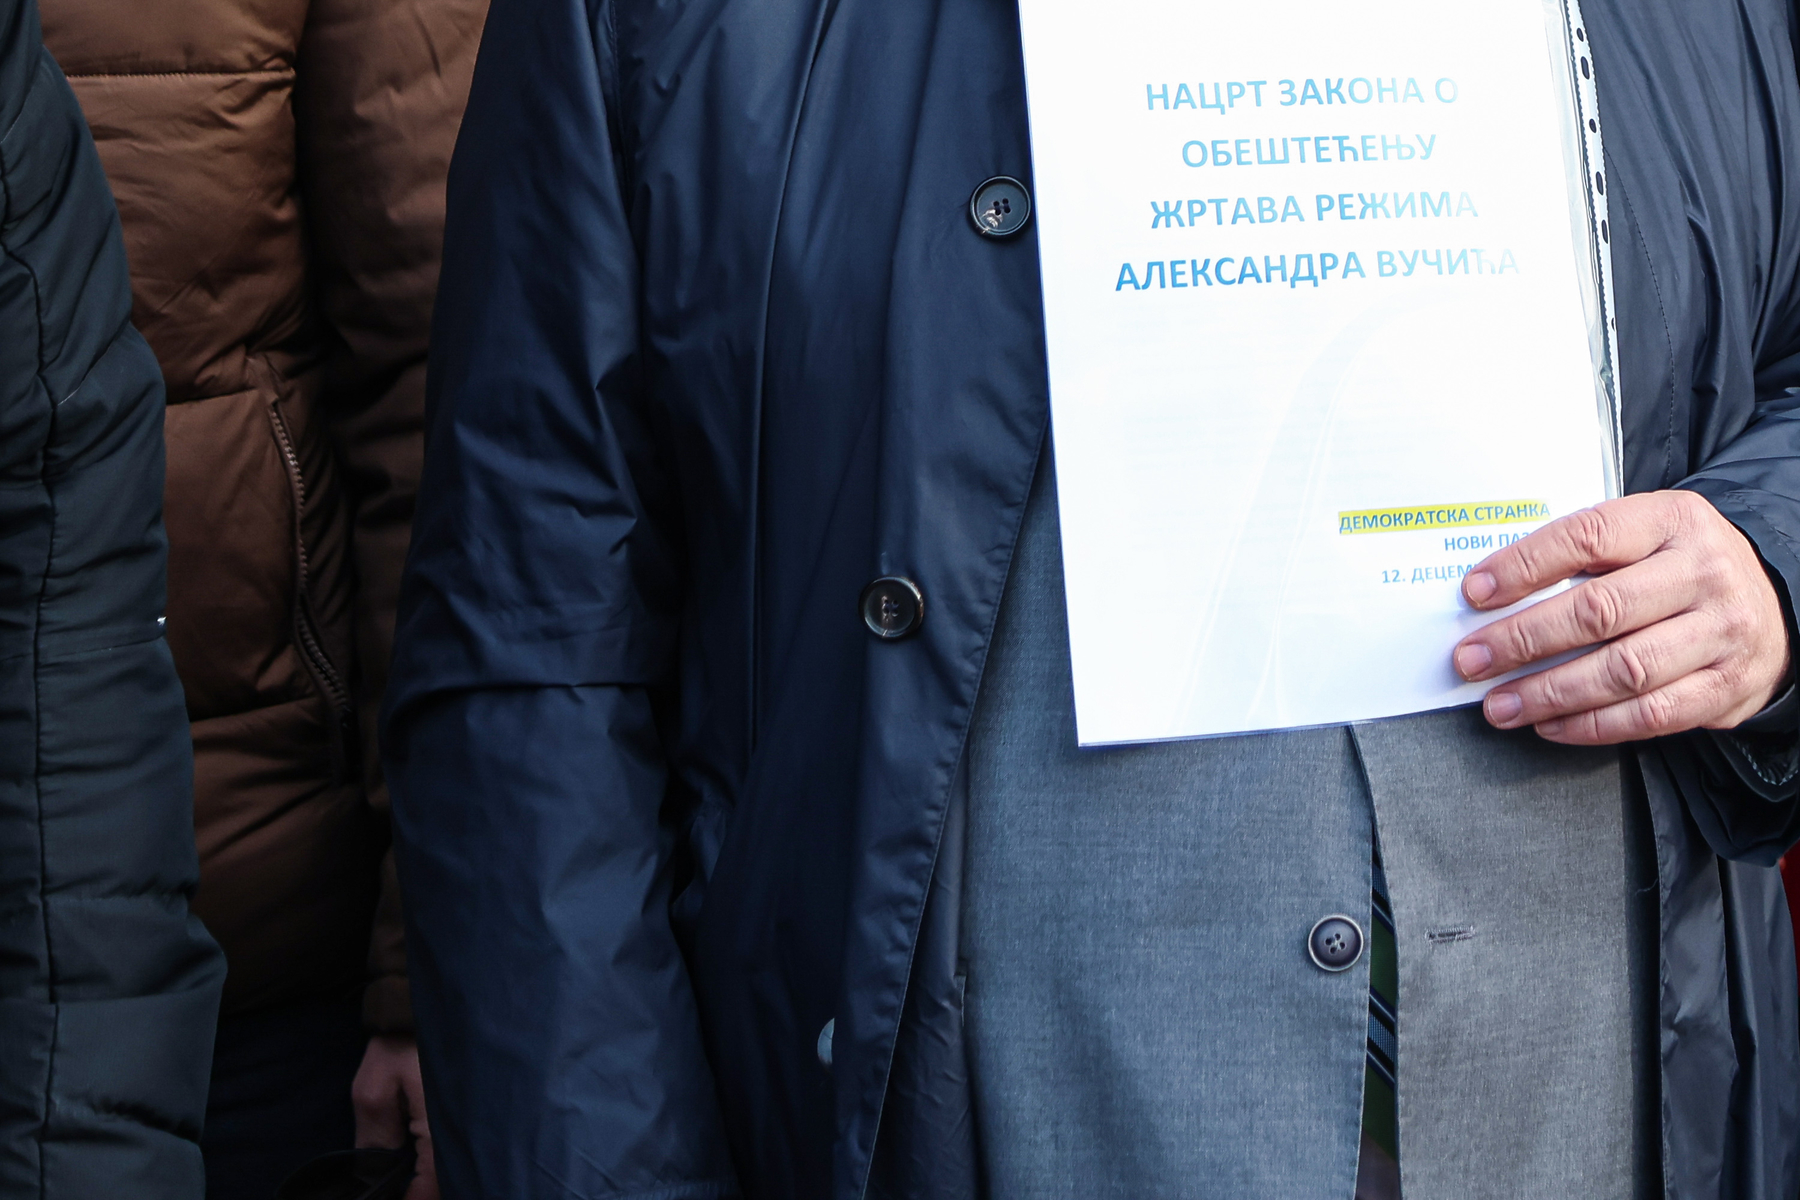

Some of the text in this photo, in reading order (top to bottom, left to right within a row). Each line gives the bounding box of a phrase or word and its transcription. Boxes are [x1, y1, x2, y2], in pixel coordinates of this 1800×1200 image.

[1146, 77, 1459, 115] НАЦРТ ЗАКОНА О
[1181, 134, 1437, 168] ОБЕШТЕЋЕЊУ
[1150, 191, 1478, 230] ЖРТАВА РЕЖИМА
[1115, 248, 1520, 292] АЛЕКСАНДРА ВУЧИЋА
[1339, 503, 1550, 533] ДЕМОКРАТСКА СТРАНКА
[1445, 535, 1493, 551] НОВИ
[1382, 570, 1405, 583] 12.
